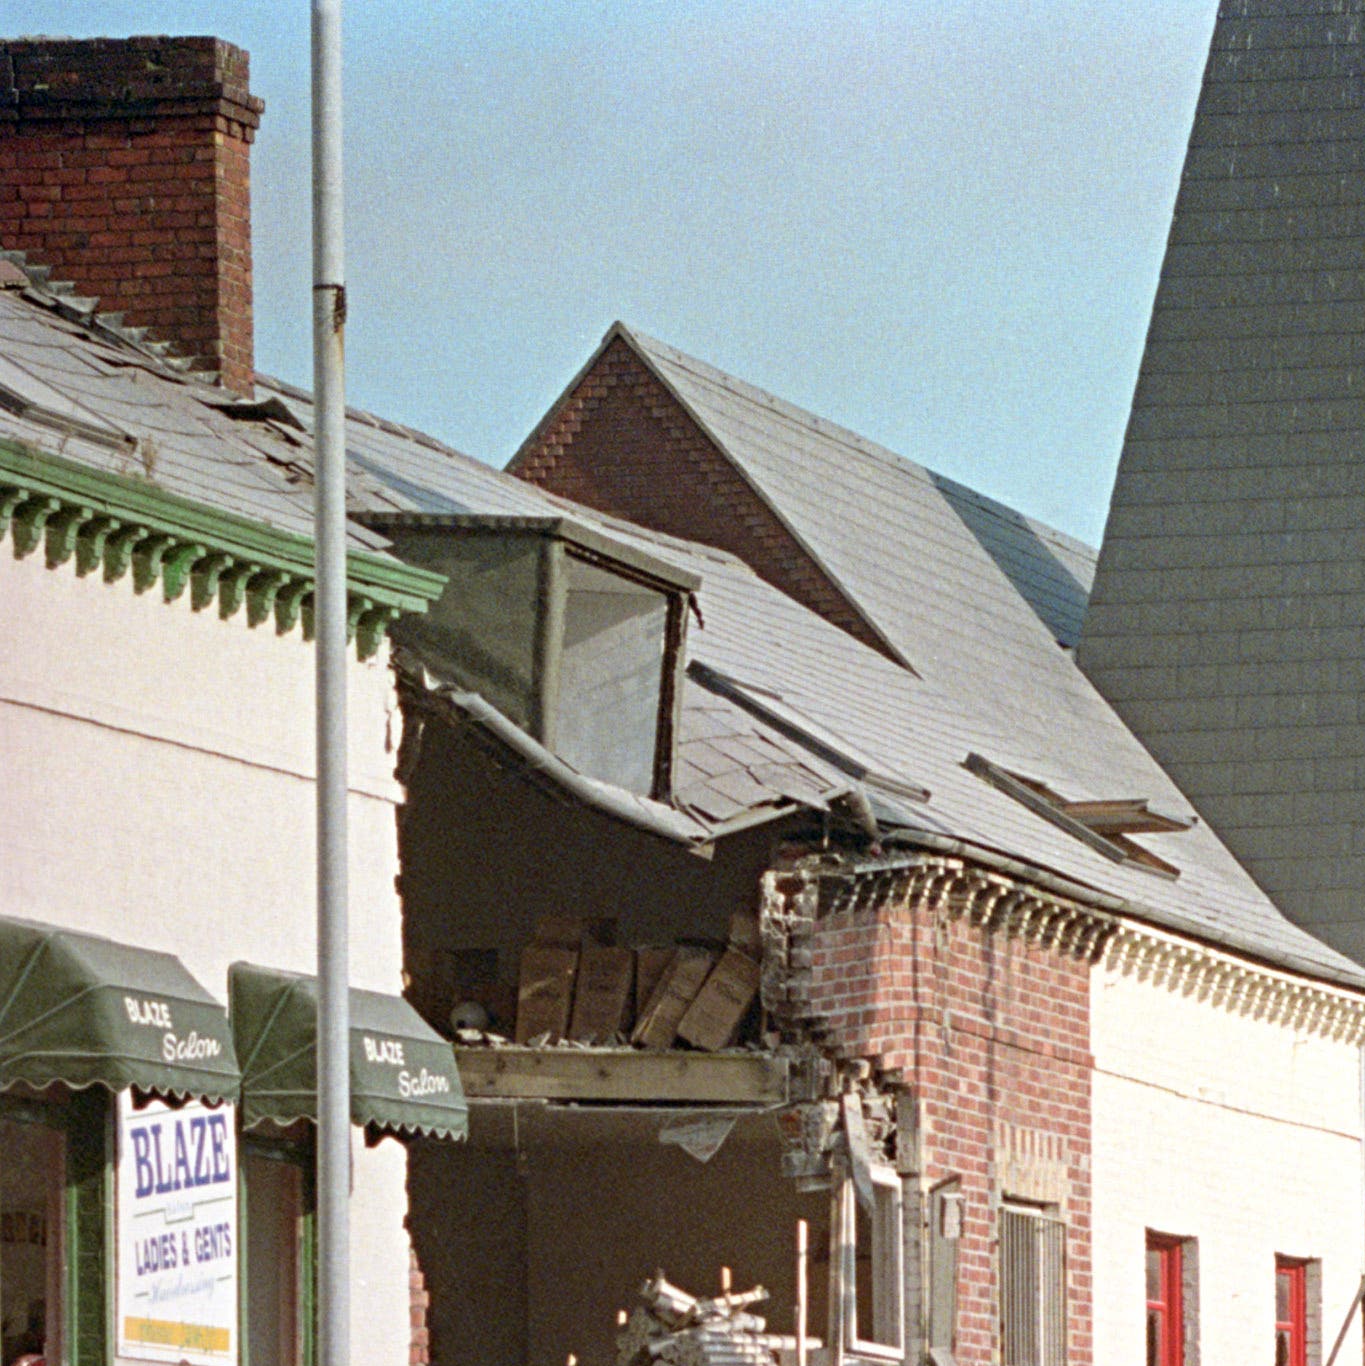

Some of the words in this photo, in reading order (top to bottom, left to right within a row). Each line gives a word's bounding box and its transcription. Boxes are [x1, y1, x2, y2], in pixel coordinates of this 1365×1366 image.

[124, 997, 172, 1028] BLAZE
[162, 1032, 222, 1061] Salon
[363, 1036, 405, 1065] BLAZE
[398, 1069, 450, 1098] Salon
[131, 1113, 230, 1198] BLAZE
[135, 1232, 178, 1277] LADIES
[182, 1229, 190, 1264] &
[194, 1221, 232, 1265] GENTS
